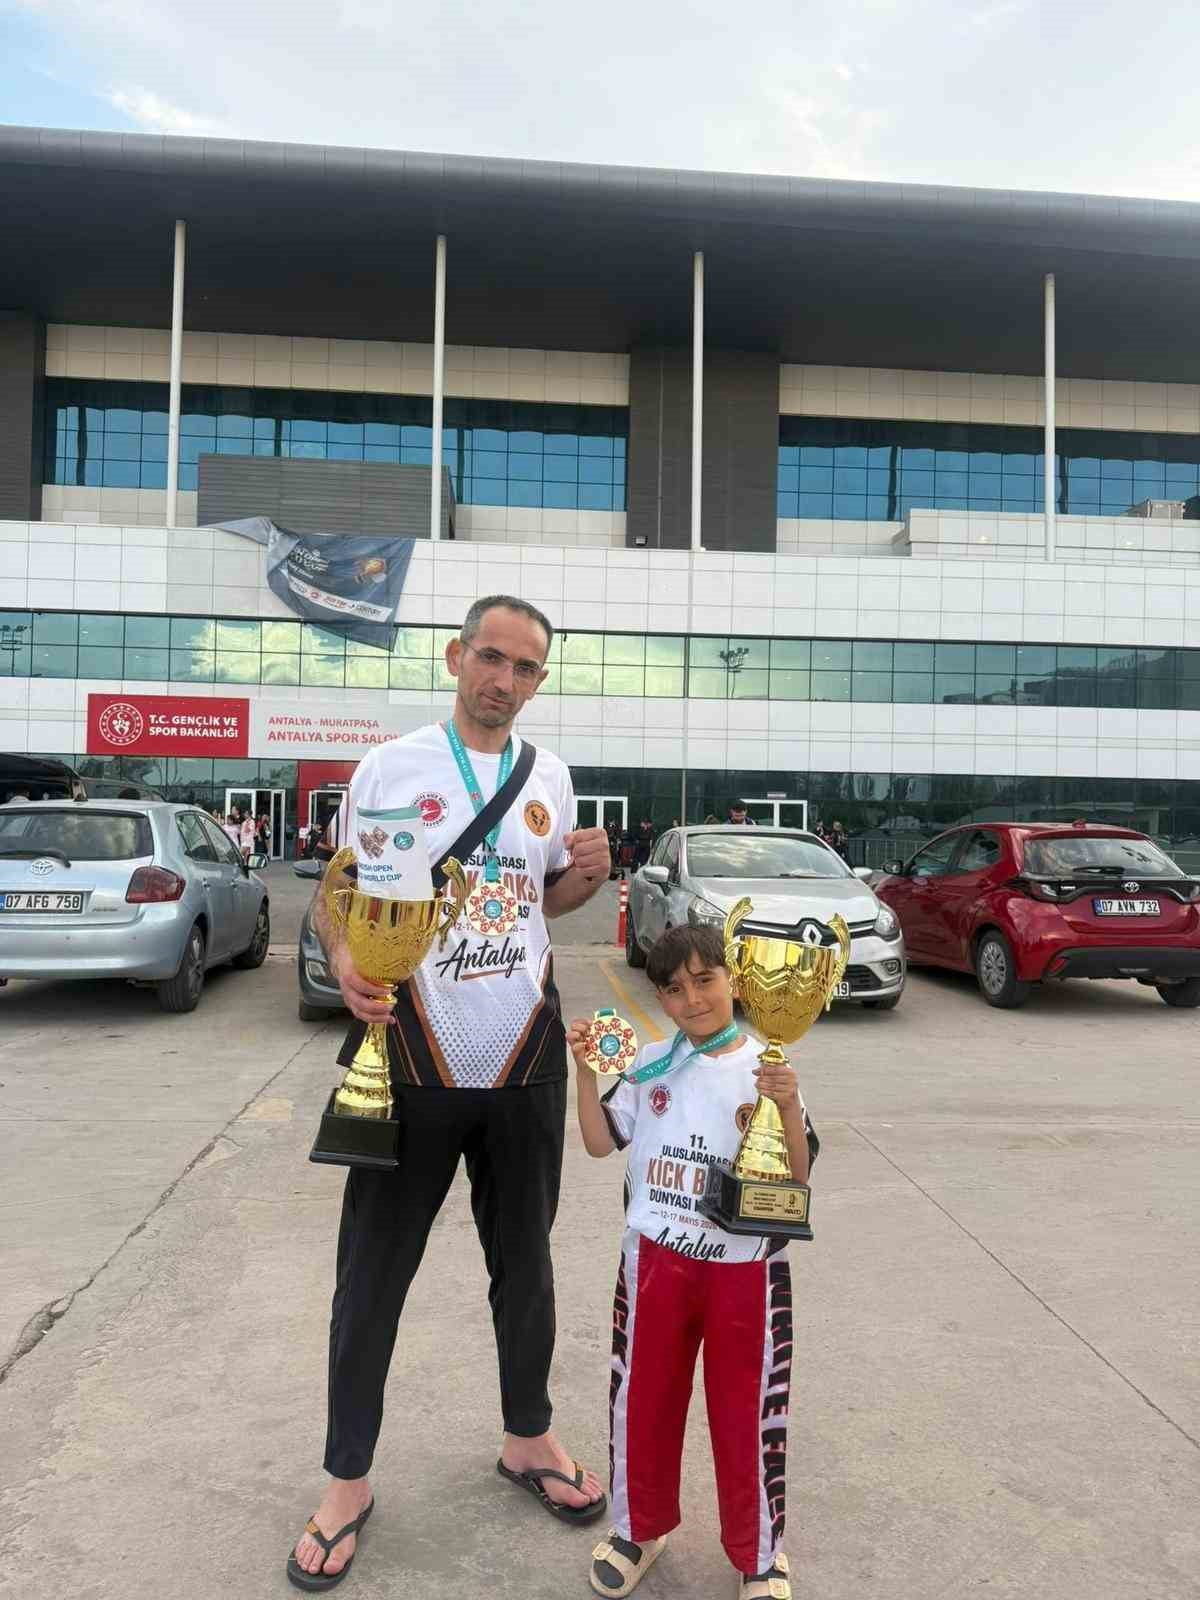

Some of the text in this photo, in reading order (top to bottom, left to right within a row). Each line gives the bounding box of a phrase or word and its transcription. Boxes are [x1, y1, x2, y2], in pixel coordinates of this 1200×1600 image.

[149, 714, 238, 727] T.C. GENÇLİK VE
[268, 716, 312, 726] ANTALYA
[320, 718, 380, 729] MURATPAŞA
[149, 726, 238, 737] SPOR BAKANLIĞI
[268, 730, 323, 742] ANTALYA
[326, 732, 360, 744] SPOR
[373, 864, 393, 872] OPEN
[386, 873, 402, 881] CUP
[5, 895, 80, 908] 07 AFG 758
[1103, 901, 1158, 912] 07 AVN 732
[690, 1134, 707, 1150] 11.
[661, 1210, 677, 1220] 12-17
[679, 1216, 700, 1228] MAYIS
